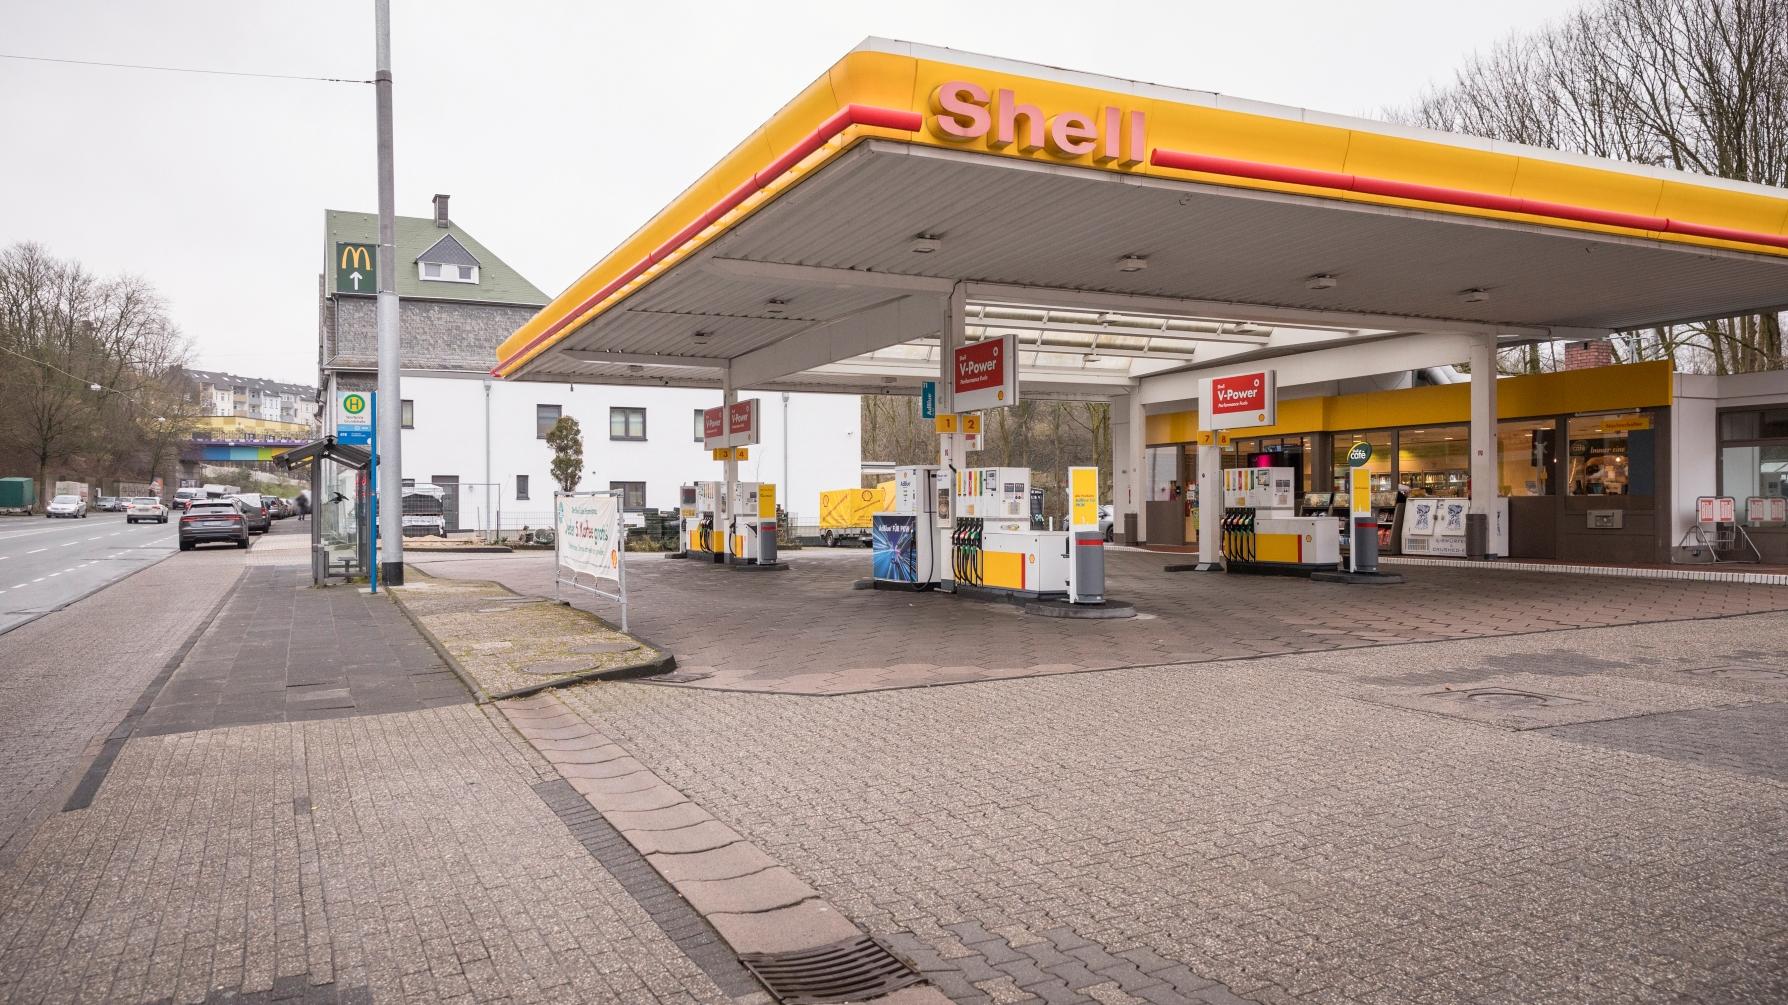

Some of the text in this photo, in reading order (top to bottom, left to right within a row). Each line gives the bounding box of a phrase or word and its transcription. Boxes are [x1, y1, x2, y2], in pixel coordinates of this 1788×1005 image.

[932, 81, 1145, 166] Shell
[960, 359, 996, 376] V-Power
[1218, 389, 1258, 401] V-Power
[350, 399, 358, 410] H
[946, 418, 950, 428] 1
[968, 420, 974, 429] 2
[1205, 434, 1210, 442] 7
[1222, 436, 1226, 444] 8
[1590, 446, 1611, 454] Immer
